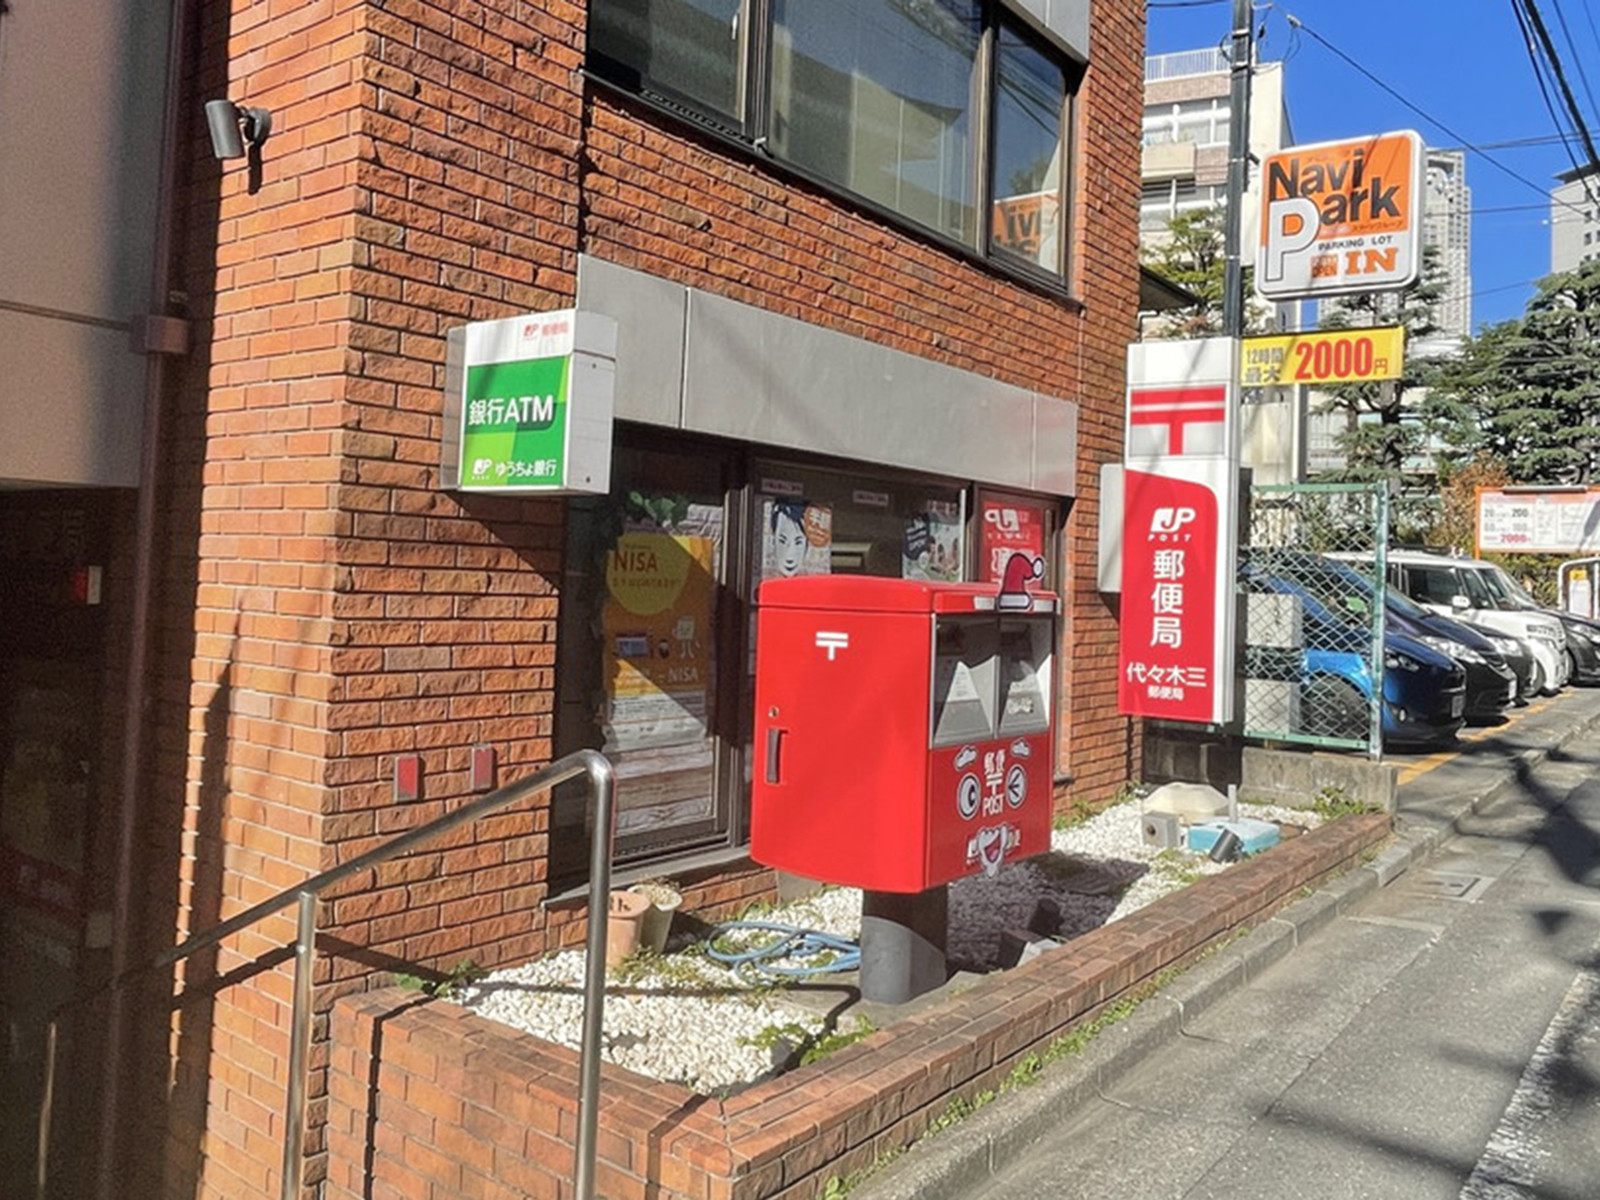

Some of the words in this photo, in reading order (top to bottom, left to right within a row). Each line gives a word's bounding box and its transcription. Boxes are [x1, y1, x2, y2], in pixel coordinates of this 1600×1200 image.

[1269, 148, 1364, 199] Navi
[1265, 176, 1401, 282] Park
[1318, 238, 1364, 251] PARKING
[1371, 235, 1393, 246] LOT
[1345, 247, 1399, 276] IN
[468, 395, 554, 426] 銀行ATM
[496, 459, 557, 477] ゆうちょ銀行
[1147, 533, 1193, 543] POST
[613, 551, 658, 572] NISA
[1150, 549, 1185, 648] 郵便局
[668, 666, 699, 683] NISA
[1126, 662, 1208, 688] 代々木三
[982, 793, 1005, 818] POST
